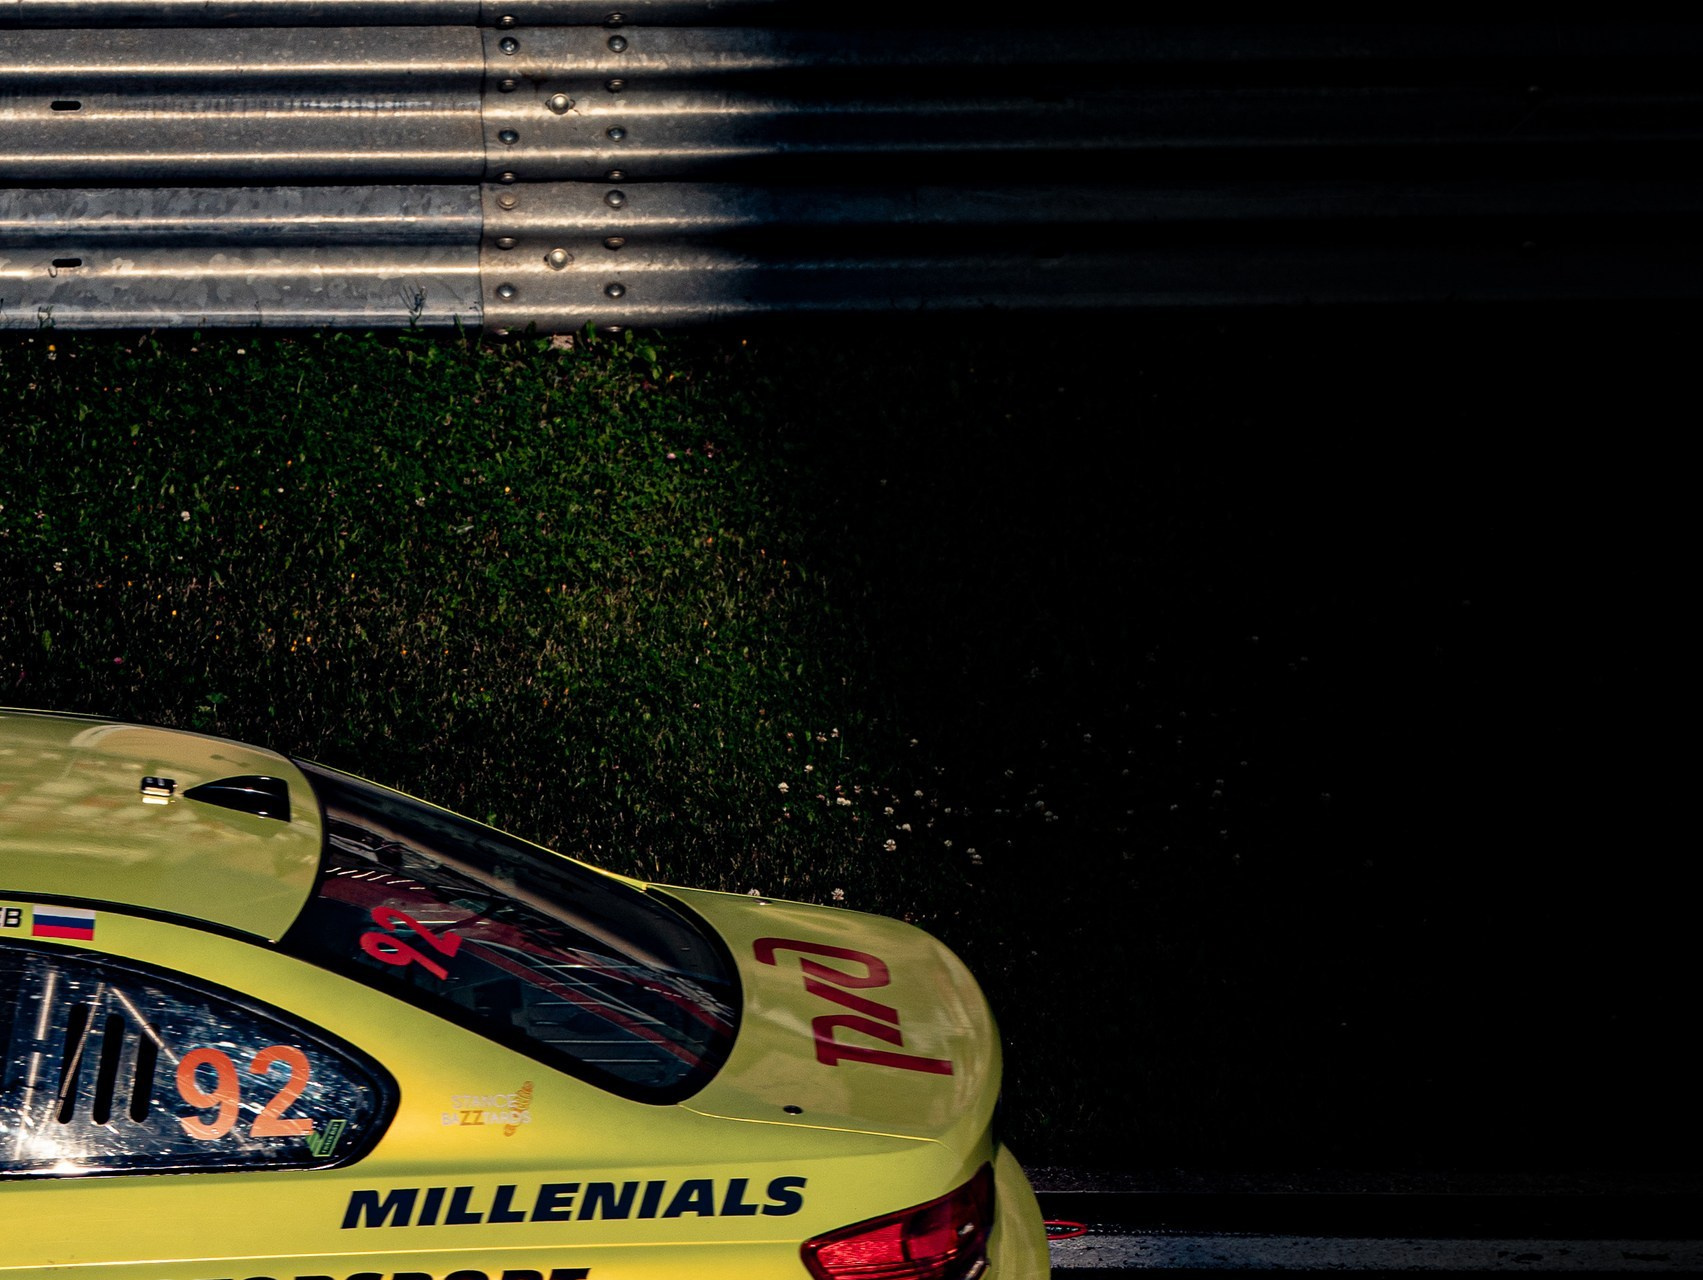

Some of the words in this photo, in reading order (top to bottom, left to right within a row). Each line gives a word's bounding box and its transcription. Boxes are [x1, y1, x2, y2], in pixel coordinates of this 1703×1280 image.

[359, 905, 462, 981] 92
[176, 1044, 314, 1140] 92
[340, 1175, 808, 1230] MILLENIALS
